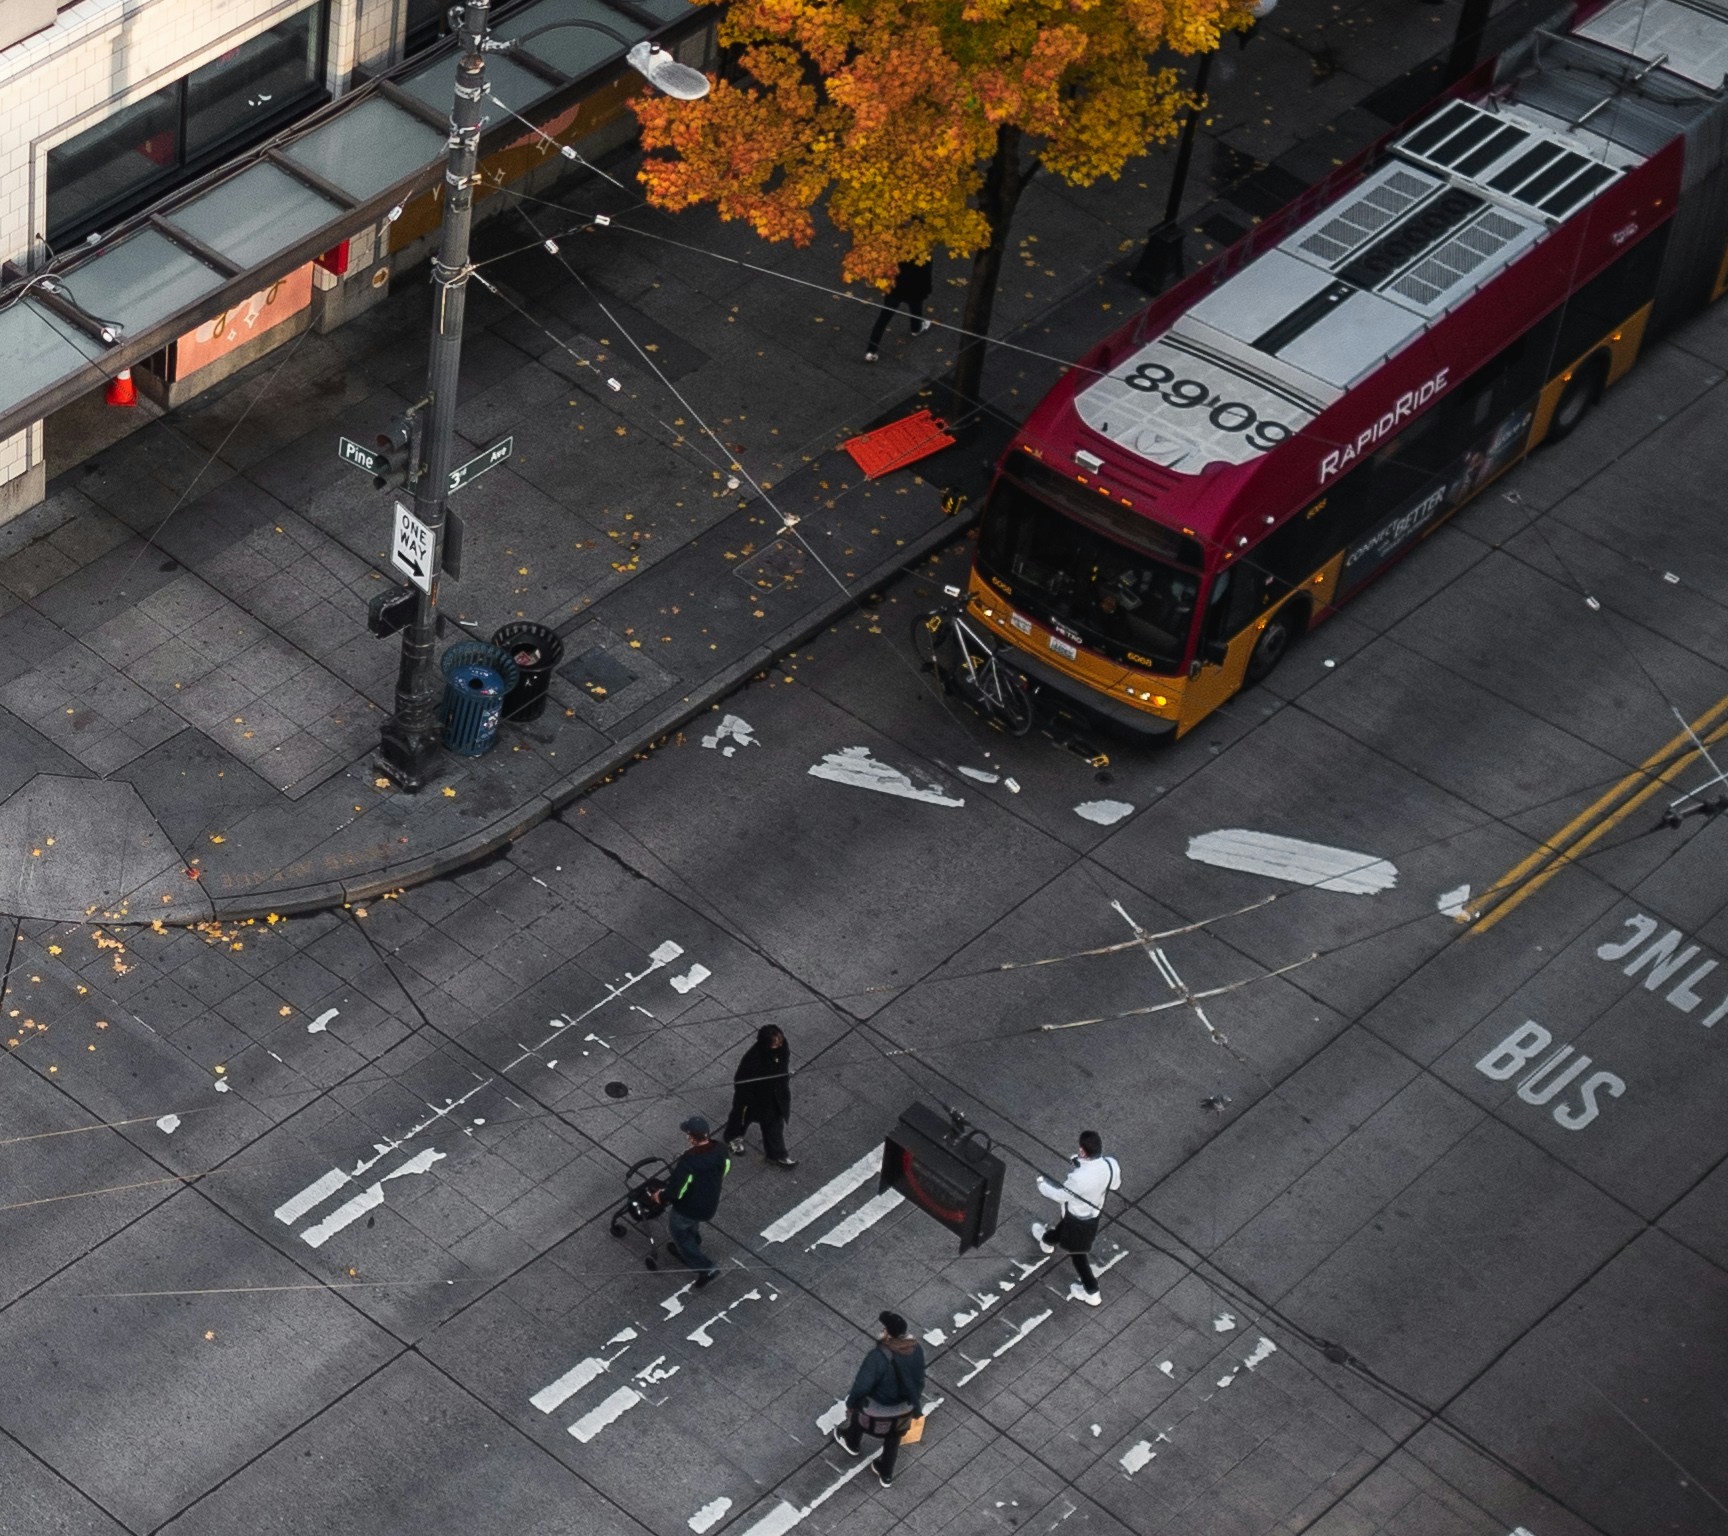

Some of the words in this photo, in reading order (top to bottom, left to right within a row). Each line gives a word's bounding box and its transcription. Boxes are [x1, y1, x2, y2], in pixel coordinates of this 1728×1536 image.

[345, 443, 374, 469] Pine
[449, 468, 467, 489] 3rd
[490, 447, 507, 463] Ave
[400, 530, 427, 561] WAY
[402, 515, 427, 547] ONE
[991, 576, 1012, 596] 6068
[1127, 651, 1152, 668] 6068
[1597, 913, 1728, 1028] ONL
[1475, 1020, 1626, 1131] BUS
